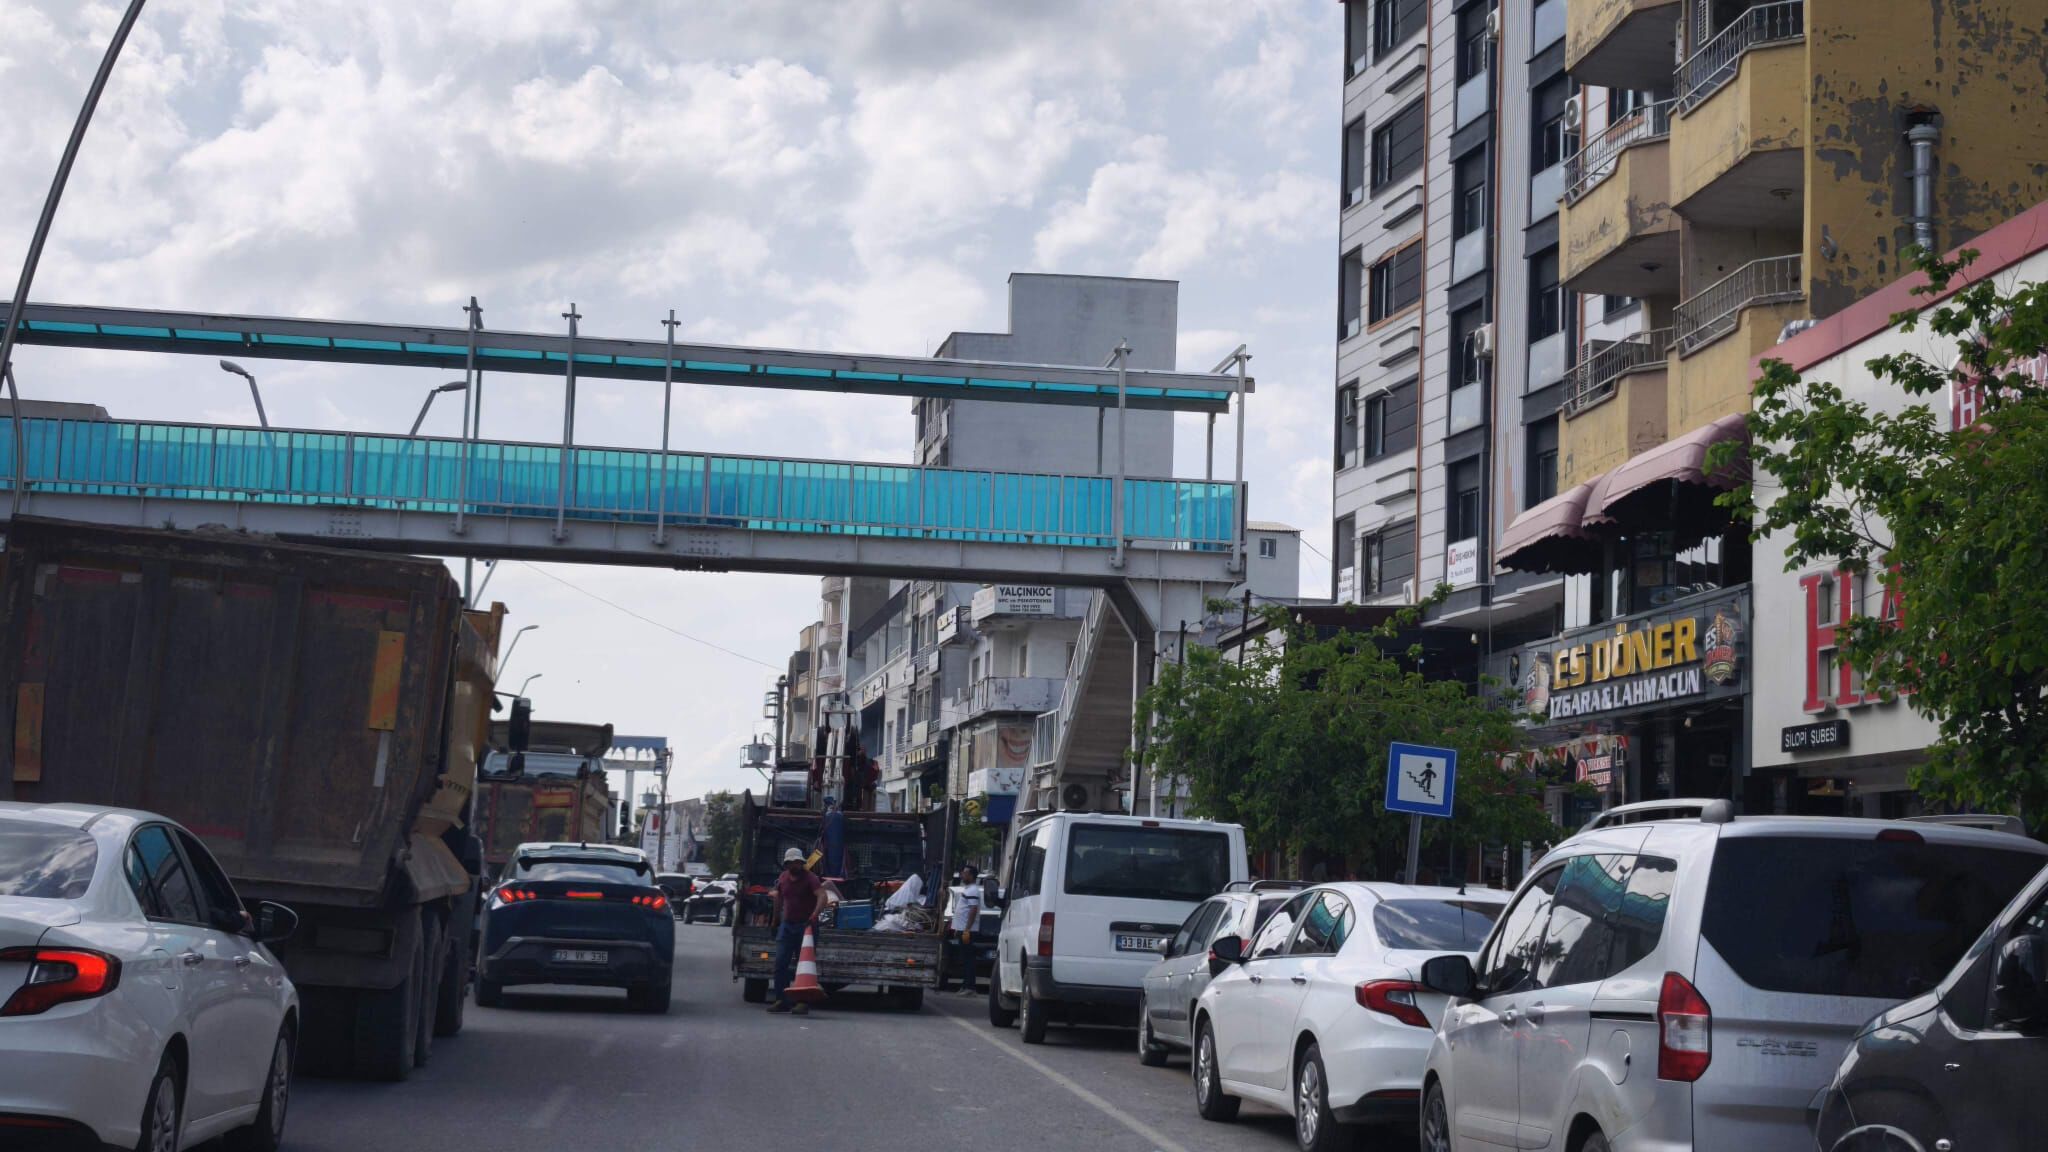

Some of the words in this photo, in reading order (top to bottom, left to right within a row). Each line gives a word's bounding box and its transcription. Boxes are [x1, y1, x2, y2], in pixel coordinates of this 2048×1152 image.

[1553, 644, 1586, 690] ES
[1592, 617, 1697, 682] DÖNER
[1785, 728, 1807, 748] SİLOPİ
[1810, 722, 1837, 747] ŞUBESİ
